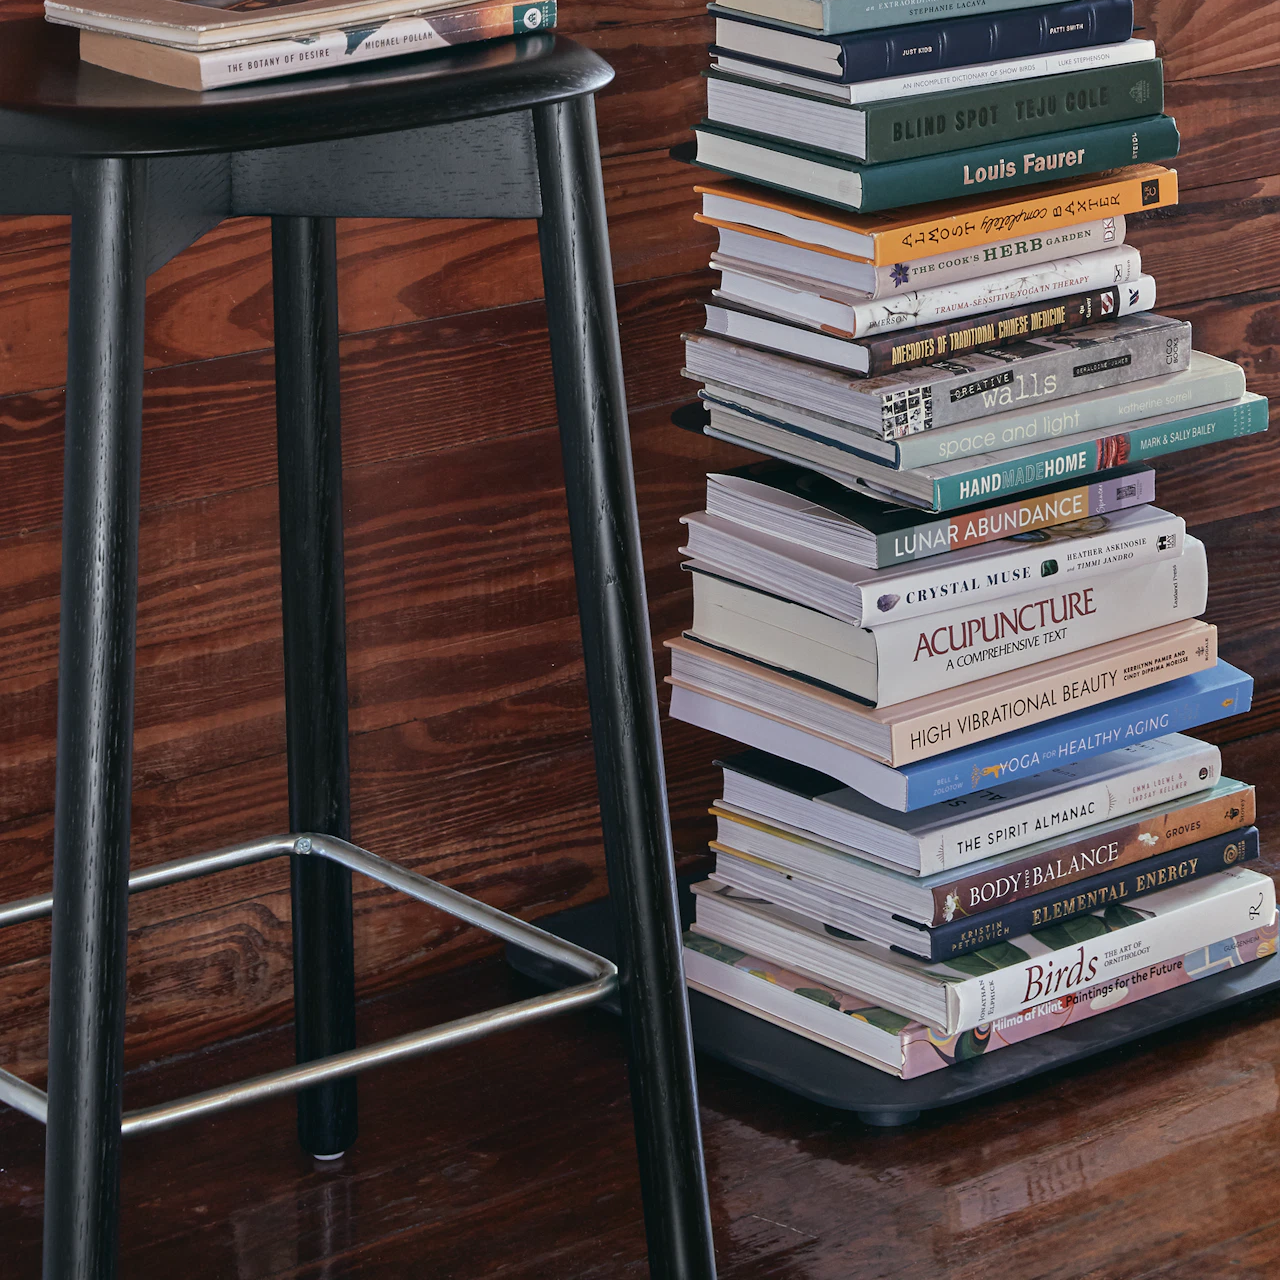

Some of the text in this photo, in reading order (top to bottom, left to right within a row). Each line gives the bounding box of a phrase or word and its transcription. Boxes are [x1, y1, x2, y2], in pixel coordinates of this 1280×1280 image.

[365, 31, 434, 50] MICHAEL POLLAN
[1049, 23, 1084, 34] PATTI SMITH
[227, 47, 330, 73] THE BOTANY OF DESIRE
[902, 47, 916, 56] JUST
[1014, 87, 1108, 120] TEJU COLE
[892, 106, 998, 142] BLIND SPOT
[963, 148, 1085, 185] Louis Faurer
[1103, 218, 1115, 241] DK
[912, 230, 1092, 275] THE COOK'S HERB GARDEN
[891, 306, 1066, 365] ANECDOTES OF TRADITIONAL CHINESE MEDICINE
[954, 373, 1010, 399] CREATIVE
[982, 372, 1058, 408] walls
[938, 412, 1081, 458] space and light
[1140, 422, 1216, 450] MARK & SALLY BAILEY
[894, 495, 1083, 557] LUNAR ABUNDANCE
[906, 566, 1032, 604] CRYSTAL MUSE
[912, 587, 1097, 662] ACUPUNCTURE
[946, 628, 1067, 671] A COMPREHENSIVE TEXT
[910, 669, 1118, 750] HIGH VIBRATIONAL BEAUTY
[999, 713, 1169, 775] YOGA FOR HEALTHY AGING
[957, 801, 1096, 855] THE SPIRIT ALMANAC
[1165, 819, 1201, 839] GROVES
[969, 871, 1023, 907] BODY
[1032, 841, 1119, 887] BALANCE
[1032, 857, 1199, 926] ELEMENTAL ENERGY
[1020, 946, 1100, 1004] Birds
[992, 958, 1183, 1033] Hilma af Klint Paintings for the Future
